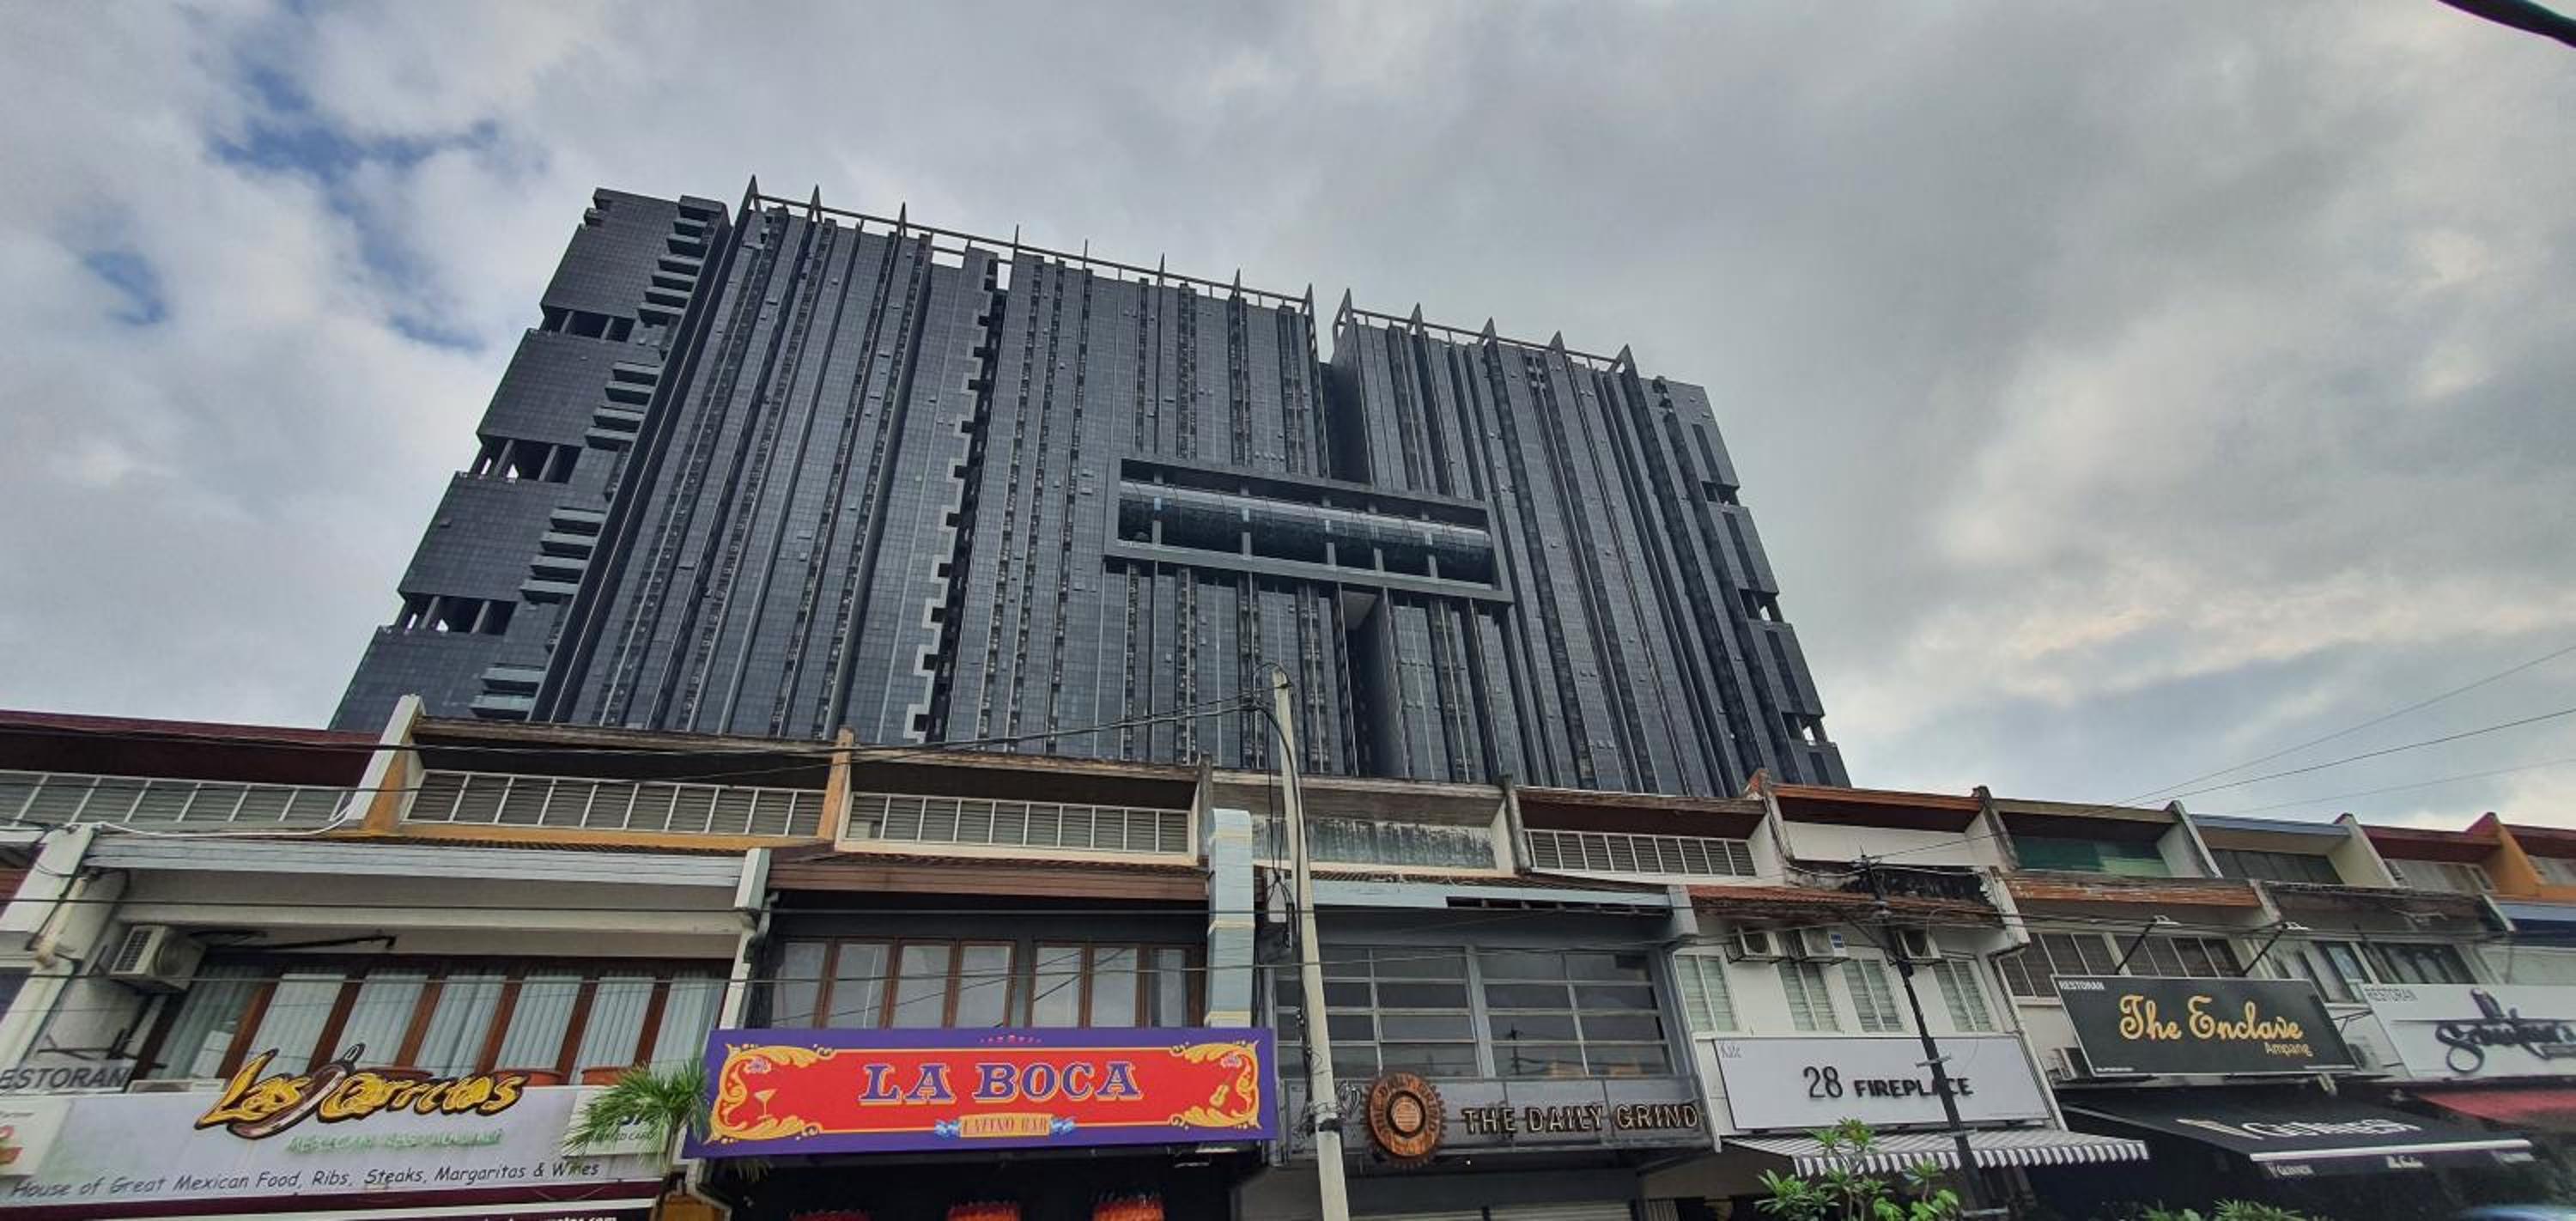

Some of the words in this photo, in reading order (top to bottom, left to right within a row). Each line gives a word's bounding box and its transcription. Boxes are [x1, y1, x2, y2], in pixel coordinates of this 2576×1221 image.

[2119, 993, 2182, 1041] The
[2187, 994, 2304, 1041] Enclave
[858, 1061, 957, 1105] LA
[972, 1060, 1145, 1103] BOCA
[1803, 1065, 1844, 1099] 28
[1853, 1078, 1974, 1098] FIREPLCE
[1461, 1106, 1518, 1134] THE
[1525, 1104, 1604, 1133] DAILY
[1614, 1103, 1699, 1131] GRIND
[9, 1179, 72, 1197] House
[80, 1176, 106, 1195] of
[110, 1176, 167, 1194] Great
[173, 1173, 249, 1191] Mexican
[256, 1170, 302, 1188] Food,
[312, 1169, 353, 1187] Ribs,
[364, 1167, 428, 1186] Steaks,
[434, 1163, 526, 1185] Margaritas
[532, 1162, 544, 1177] &
